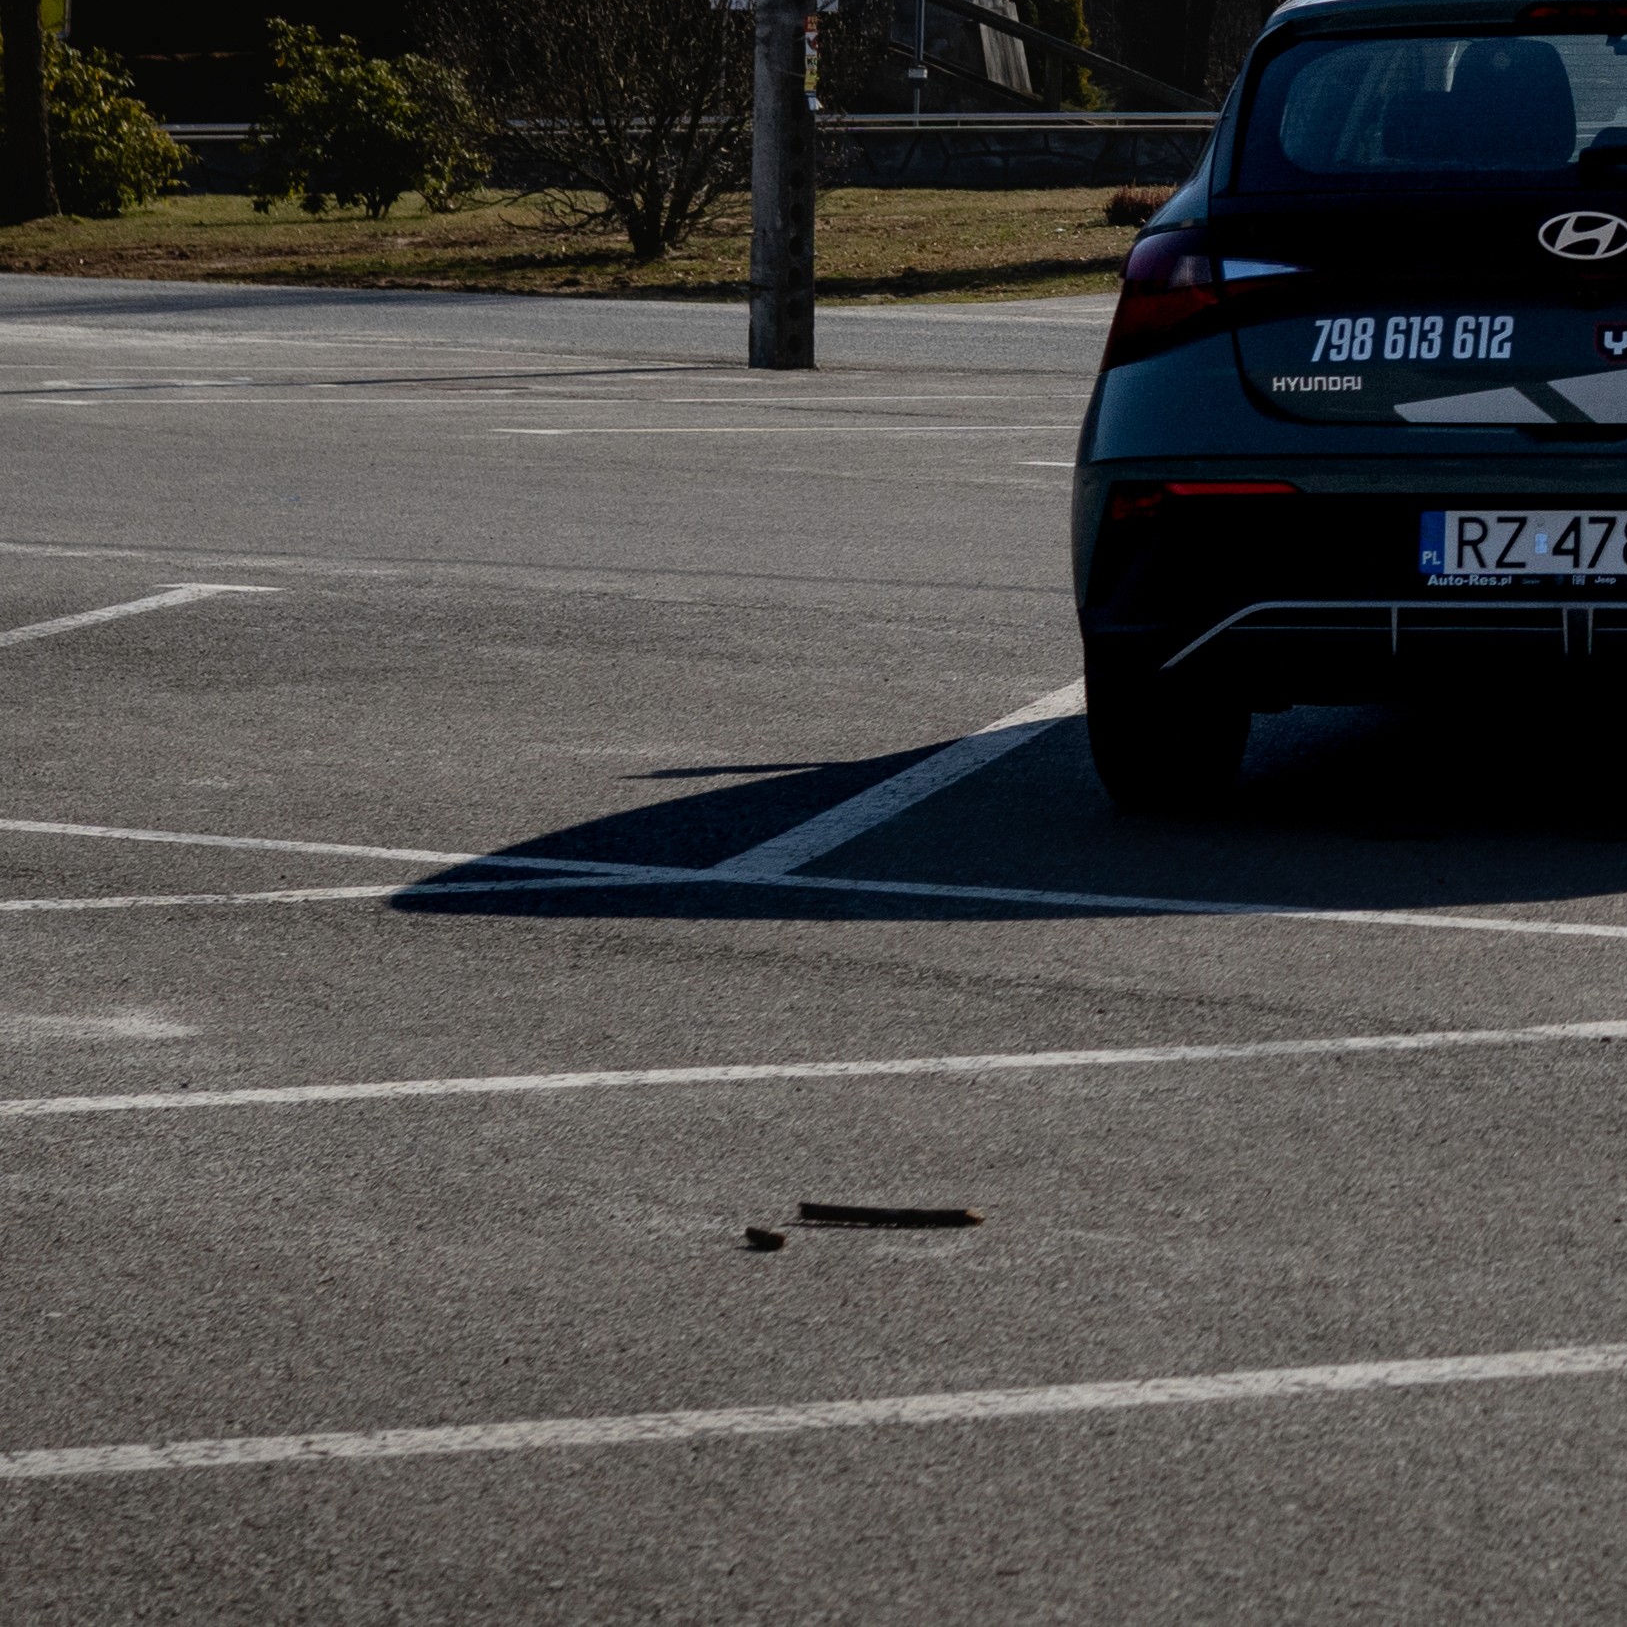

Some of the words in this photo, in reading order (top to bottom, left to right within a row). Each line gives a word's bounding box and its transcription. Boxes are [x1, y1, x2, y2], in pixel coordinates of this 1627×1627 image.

[1310, 317, 1376, 363] 798
[1383, 315, 1444, 360] 613
[1452, 315, 1515, 359] 612
[1272, 376, 1362, 391] HYUNDAI
[1457, 517, 1527, 569] RZ
[1422, 550, 1441, 566] PL
[1427, 574, 1513, 587] Auto-Res.pl
[1594, 576, 1617, 585] Jeep
